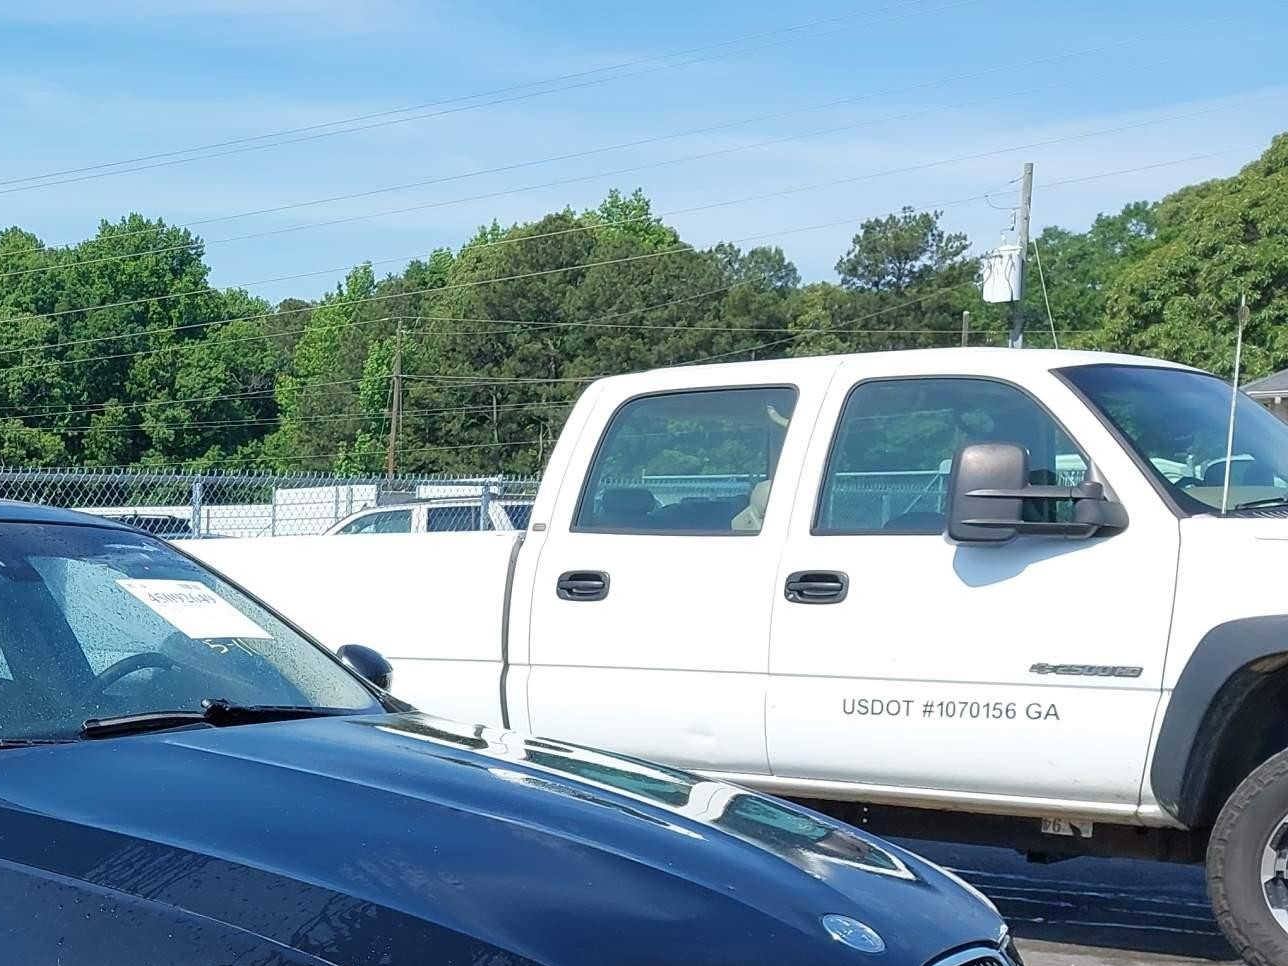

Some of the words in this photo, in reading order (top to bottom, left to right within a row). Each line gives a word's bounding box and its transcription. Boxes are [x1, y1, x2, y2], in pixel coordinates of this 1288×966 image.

[842, 698, 914, 717] USDOT
[922, 699, 1017, 720] #1070156
[1025, 702, 1061, 721] GA
